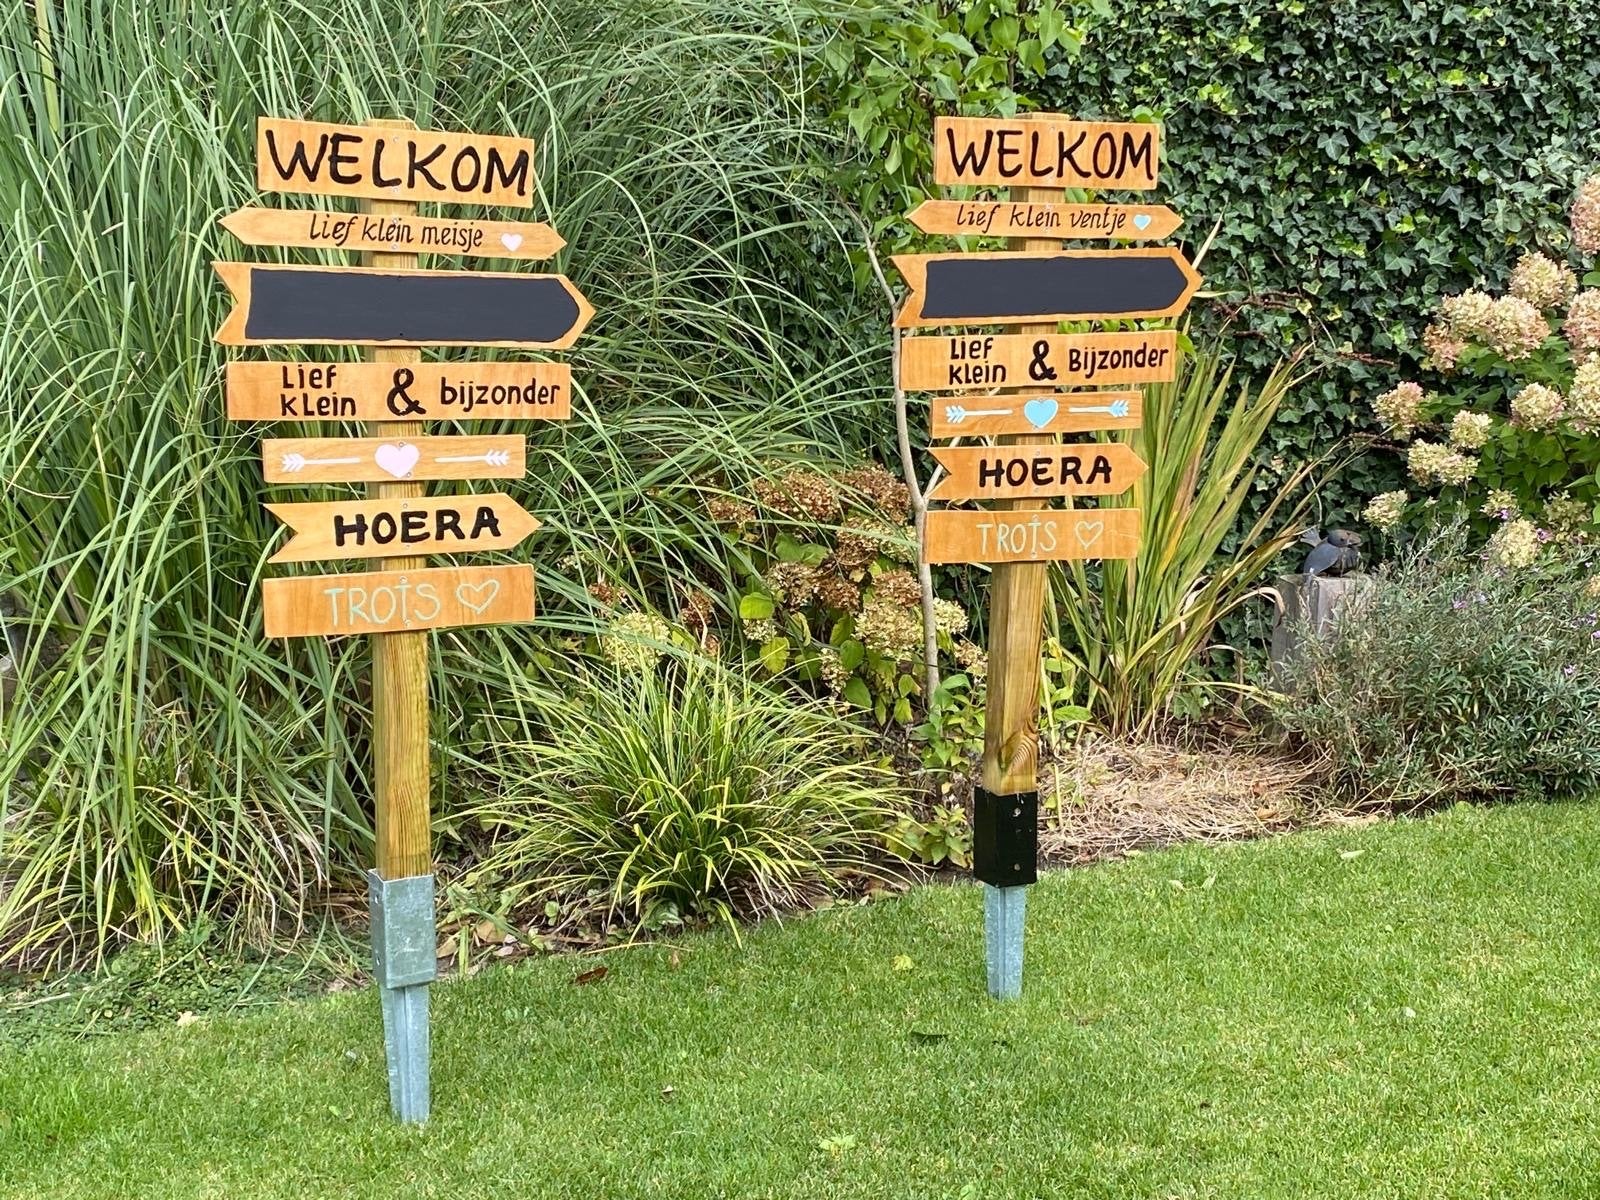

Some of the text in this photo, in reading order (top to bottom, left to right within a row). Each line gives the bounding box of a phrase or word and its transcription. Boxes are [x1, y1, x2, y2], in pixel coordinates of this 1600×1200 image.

[266, 130, 529, 196] WELKOM
[946, 127, 1154, 180] WELKOM
[420, 226, 483, 252] meisje
[1070, 208, 1125, 236] ventje
[1029, 340, 1168, 381] & Bijzonder
[387, 368, 561, 415] & bijzonder
[978, 456, 1112, 487] HOERA
[335, 506, 501, 547] HOERA
